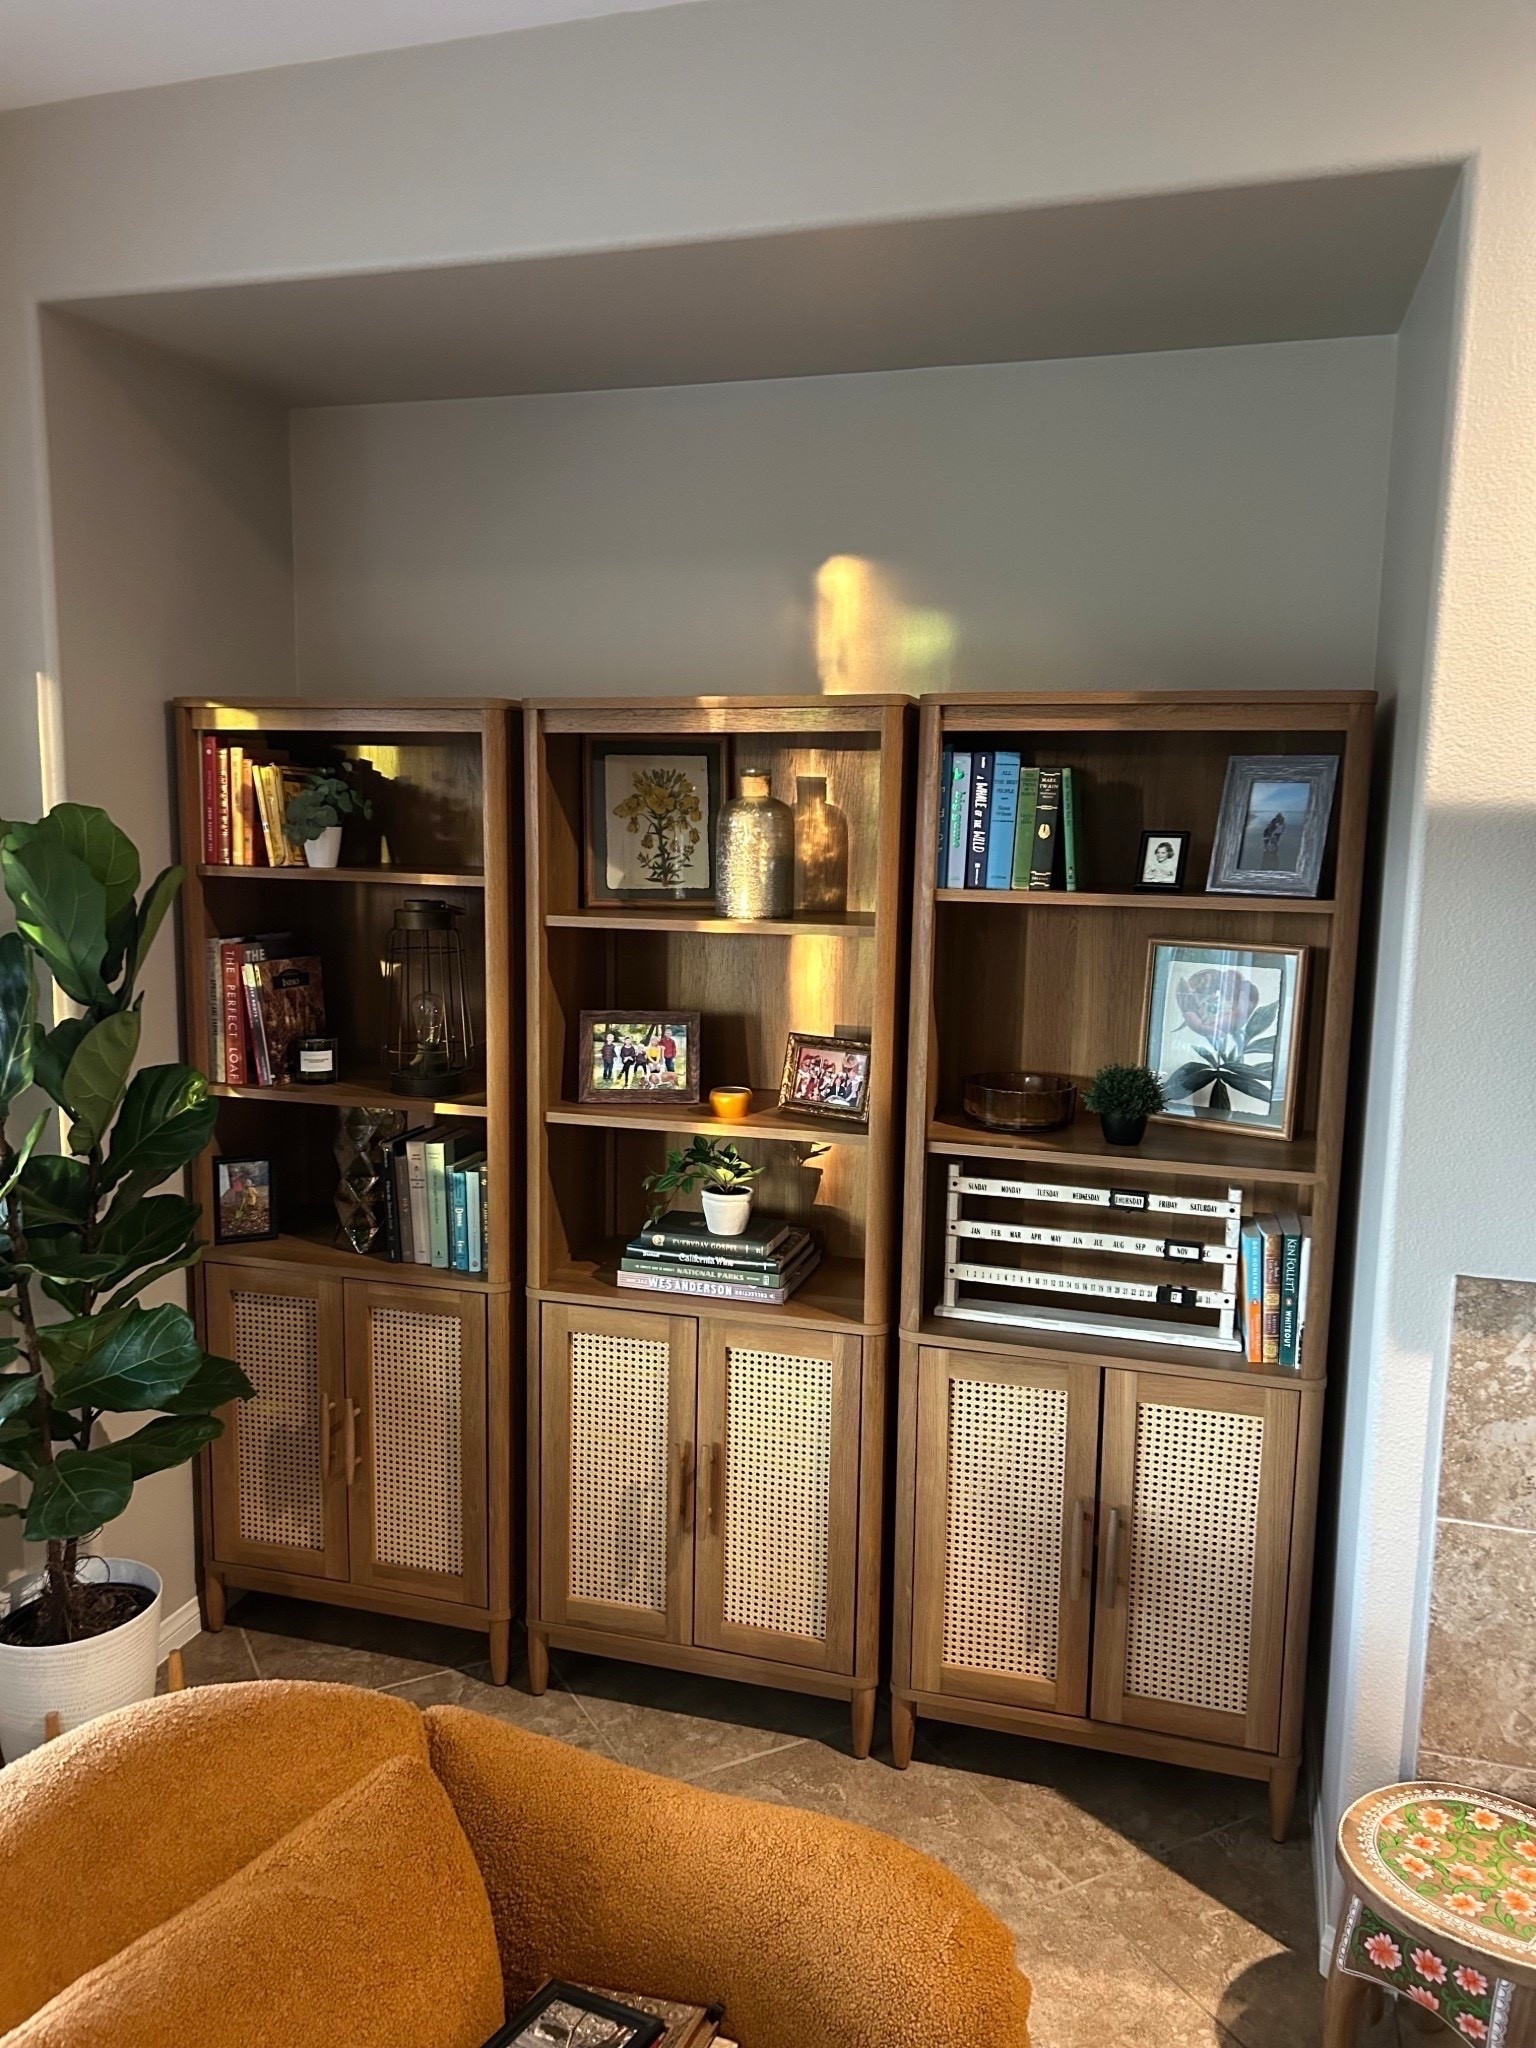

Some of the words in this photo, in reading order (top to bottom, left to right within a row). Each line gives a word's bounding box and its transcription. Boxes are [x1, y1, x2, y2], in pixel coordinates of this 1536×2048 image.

[975, 783, 988, 809] WHALE
[973, 820, 982, 829] THE
[972, 831, 985, 853] WILD
[225, 951, 236, 974] THE
[245, 949, 266, 961] THE
[227, 984, 238, 1038] PERFECT
[228, 1047, 240, 1080] LOAF
[968, 1183, 988, 1191] SUNDAY
[1001, 1185, 1022, 1194] MONDAY
[1037, 1188, 1059, 1198] TUESDAY
[1072, 1192, 1100, 1202] WEDNESDAY
[1114, 1196, 1143, 1206] THURSDAY
[1158, 1200, 1178, 1209] FRIDAY
[1190, 1203, 1218, 1213] SATURDAY
[672, 1238, 709, 1248] EVERYDAY
[711, 1242, 737, 1251] GOSPEL
[971, 1227, 981, 1235] JAN
[991, 1229, 1002, 1237] FEB
[1010, 1231, 1022, 1239] MAR
[1031, 1232, 1042, 1241] APR
[1050, 1235, 1062, 1243] MAY
[1072, 1237, 1083, 1245] JUN
[1093, 1239, 1103, 1247] JUL
[1113, 1241, 1125, 1249] AUG
[1135, 1242, 1146, 1251] SEP
[1155, 1245, 1165, 1253] OC
[1177, 1247, 1188, 1256] NOV
[1203, 1250, 1211, 1258] EC
[1286, 1238, 1298, 1256] KEN
[678, 1253, 715, 1264] California
[715, 1256, 735, 1267] Wine
[676, 1267, 716, 1278] NATIONAL
[717, 1272, 744, 1281] PARKS
[1285, 1258, 1297, 1294] FOLLETT
[649, 1276, 673, 1289] WES
[675, 1279, 732, 1296] ANDERSON
[1050, 1279, 1056, 1287] 12
[1058, 1280, 1064, 1288] 13
[1066, 1281, 1072, 1289] 14
[1074, 1282, 1080, 1290] 15
[1082, 1283, 1088, 1291] 16
[1115, 1286, 1120, 1294] 20
[1123, 1287, 1128, 1295] 21
[1131, 1288, 1137, 1296] 22
[1139, 1289, 1145, 1297] 23
[1147, 1290, 1153, 1298] 24
[1283, 1311, 1293, 1348] WHITEOUT
